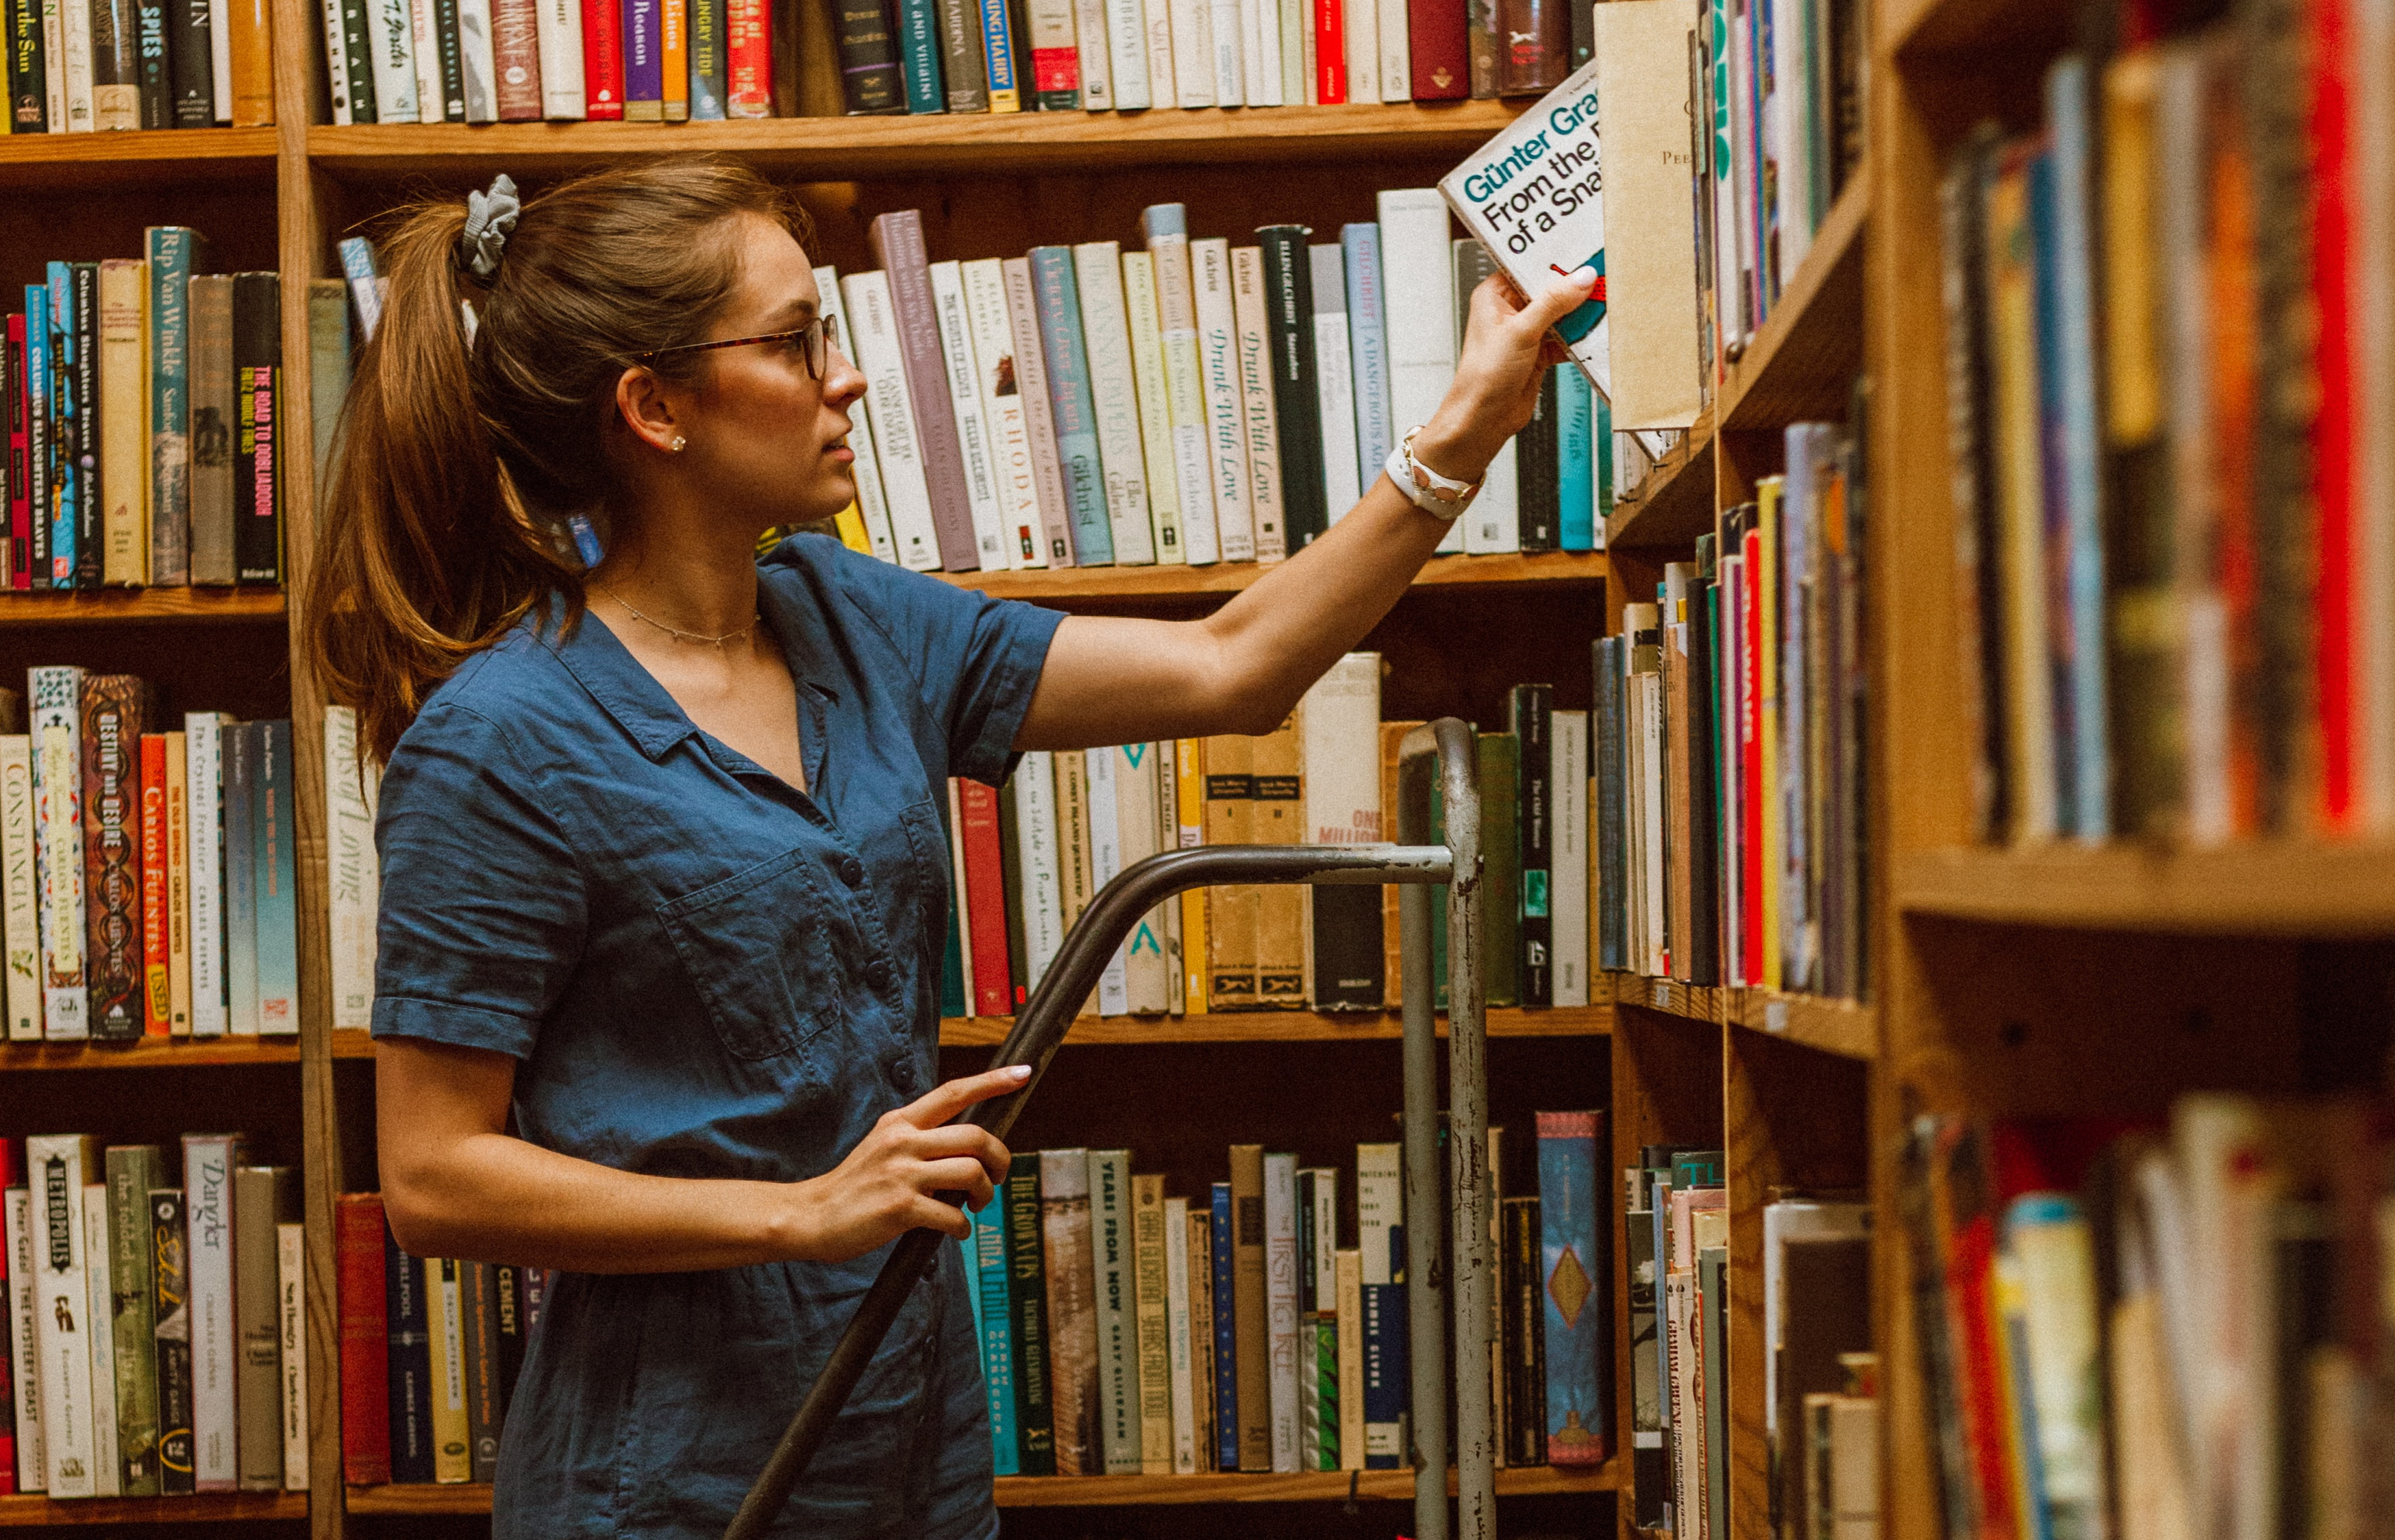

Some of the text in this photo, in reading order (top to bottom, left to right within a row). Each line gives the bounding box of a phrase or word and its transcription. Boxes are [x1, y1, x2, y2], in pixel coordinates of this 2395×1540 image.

[18, 40, 36, 73] Sun
[140, 7, 162, 58] SPIES
[634, 1, 651, 66] Reason
[697, 46, 714, 77] TIDE
[990, 34, 1010, 86] HARRY
[1464, 86, 1598, 203] Günter Gra
[1482, 137, 1596, 233] From the
[1506, 160, 1602, 254] of a Sna
[1204, 249, 1220, 293] Gilchrist
[1238, 251, 1254, 295] Gilchrist
[1358, 240, 1376, 318] GILCHRIST
[156, 234, 182, 377] Rip Van Winkle
[32, 346, 43, 417] COLUMBUS
[79, 269, 91, 450] Columbus Slaughters Braves
[254, 366, 272, 387] THE
[254, 390, 272, 422] ROAD
[1208, 329, 1241, 501] Drunk With Love
[1241, 331, 1273, 504] Drunk With Love
[1364, 349, 1384, 439] DANGEROUS
[33, 419, 45, 505] SLAUGHTERS
[255, 423, 272, 441] TO
[1003, 408, 1034, 510] RHODA
[1070, 454, 1097, 527] Gilchrist
[34, 507, 45, 559] BRAVES
[100, 714, 118, 771] DESTINY
[7, 763, 27, 912] CONSTANCIA
[103, 798, 122, 848] DESIRE
[143, 786, 166, 954] CARLOS FUENTES
[151, 971, 169, 1017] USED
[15, 1199, 30, 1232] Peter
[48, 1166, 69, 1265] METROPOLIS
[979, 1224, 1004, 1268] ANNA
[1102, 1161, 1122, 1312] YEARS FROM NOW
[20, 1287, 32, 1312] THE
[498, 1268, 515, 1335] CEMENT
[21, 1313, 35, 1375] MYSTERY
[1667, 1320, 1683, 1428] GRAHAM GREENE
